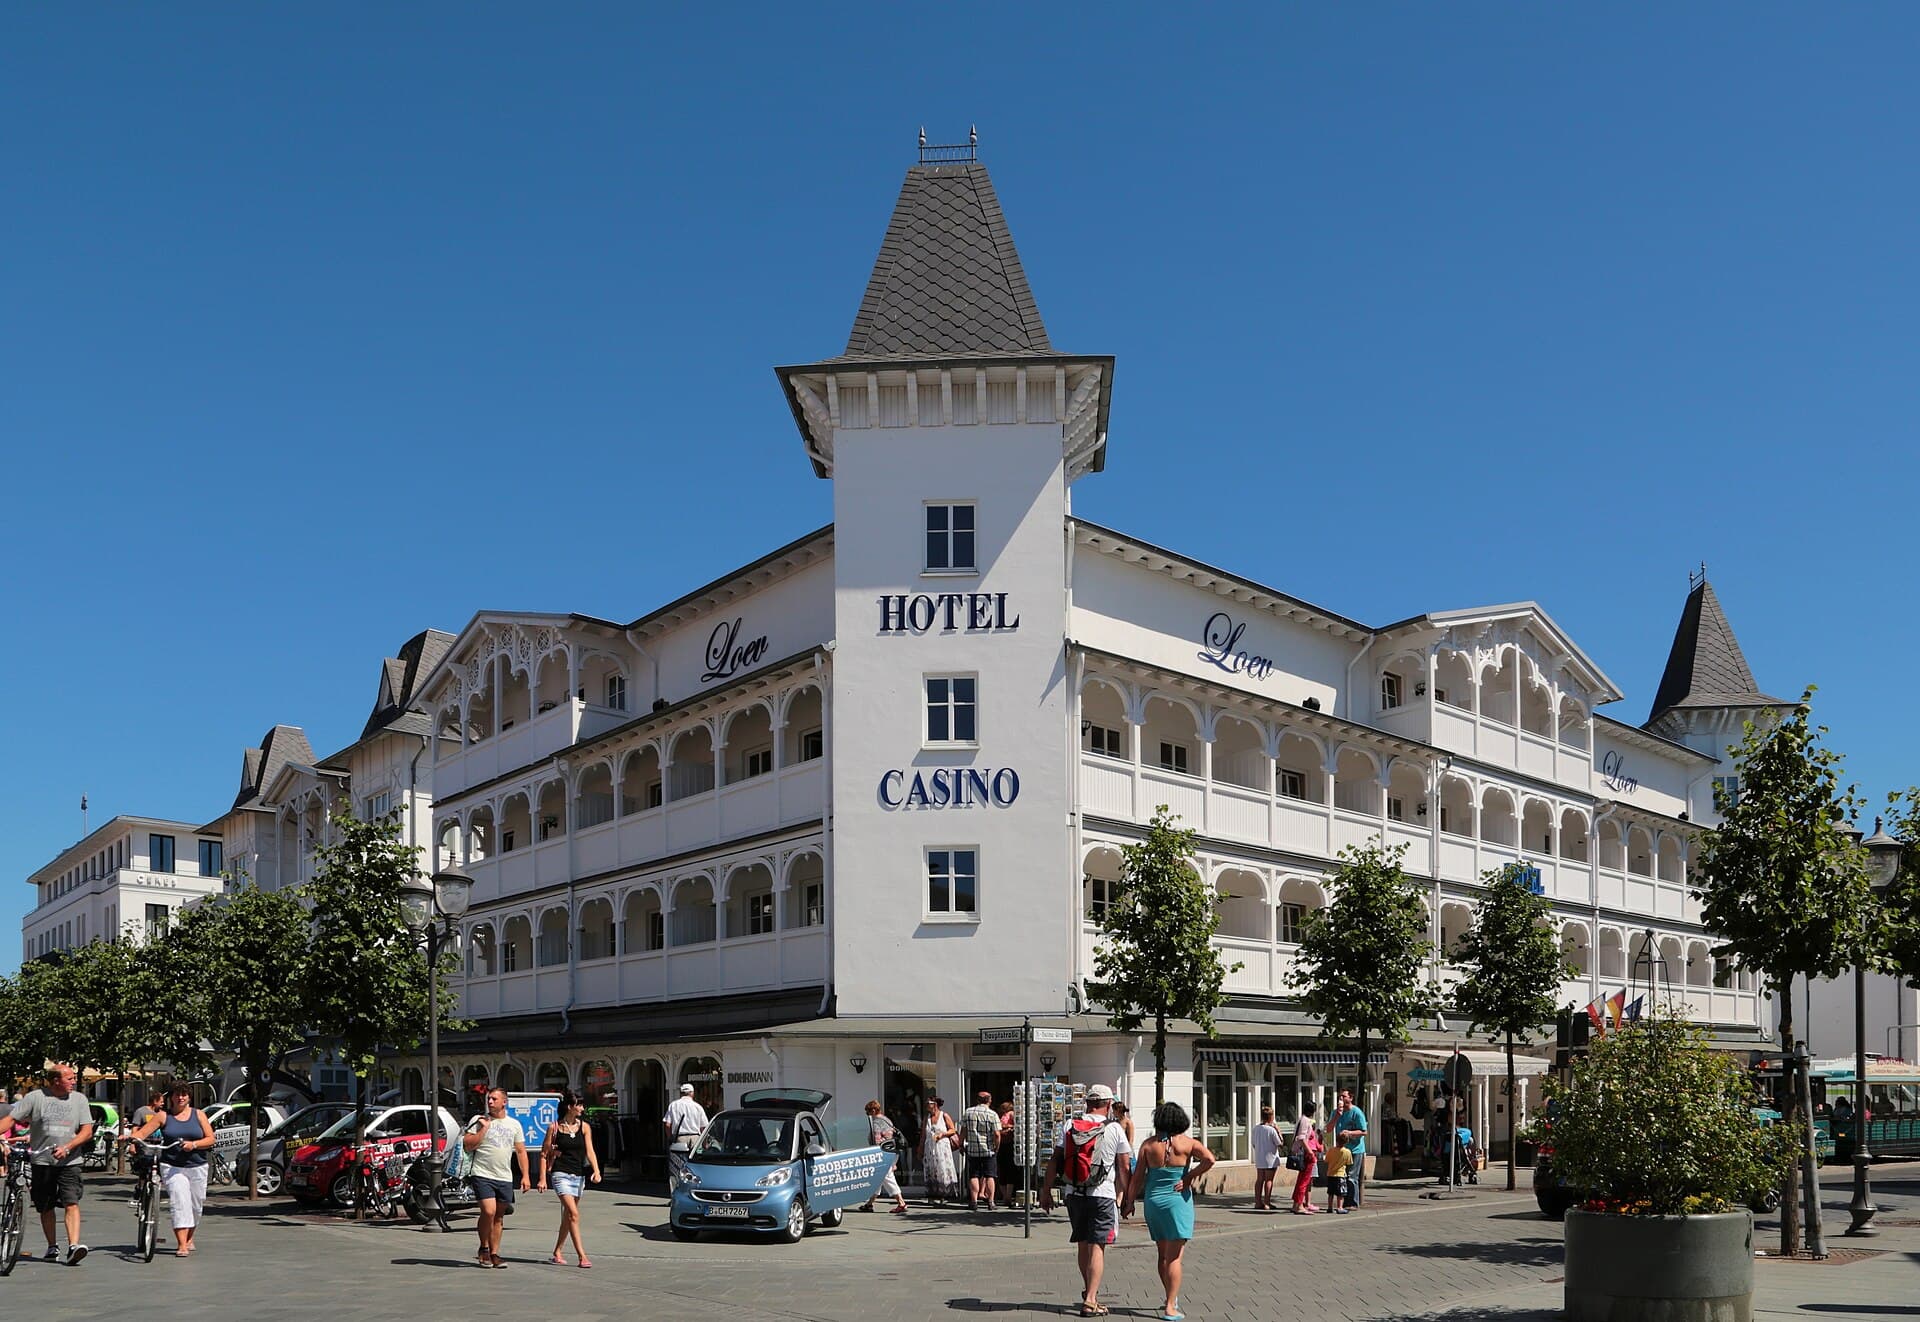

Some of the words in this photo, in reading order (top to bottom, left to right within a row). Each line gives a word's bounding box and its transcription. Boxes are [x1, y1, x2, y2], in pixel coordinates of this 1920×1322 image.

[880, 593, 1020, 631] HOTEL
[701, 617, 768, 683] Loev
[1198, 612, 1275, 681] Loev
[880, 768, 1020, 806] CASINO
[727, 1071, 773, 1083] DOHRMANN
[235, 1128, 250, 1137] CIT
[811, 1152, 884, 1175] PROBEFAHRT
[813, 1166, 876, 1188] GEFÄLLIG?
[832, 1185, 850, 1194] smart
